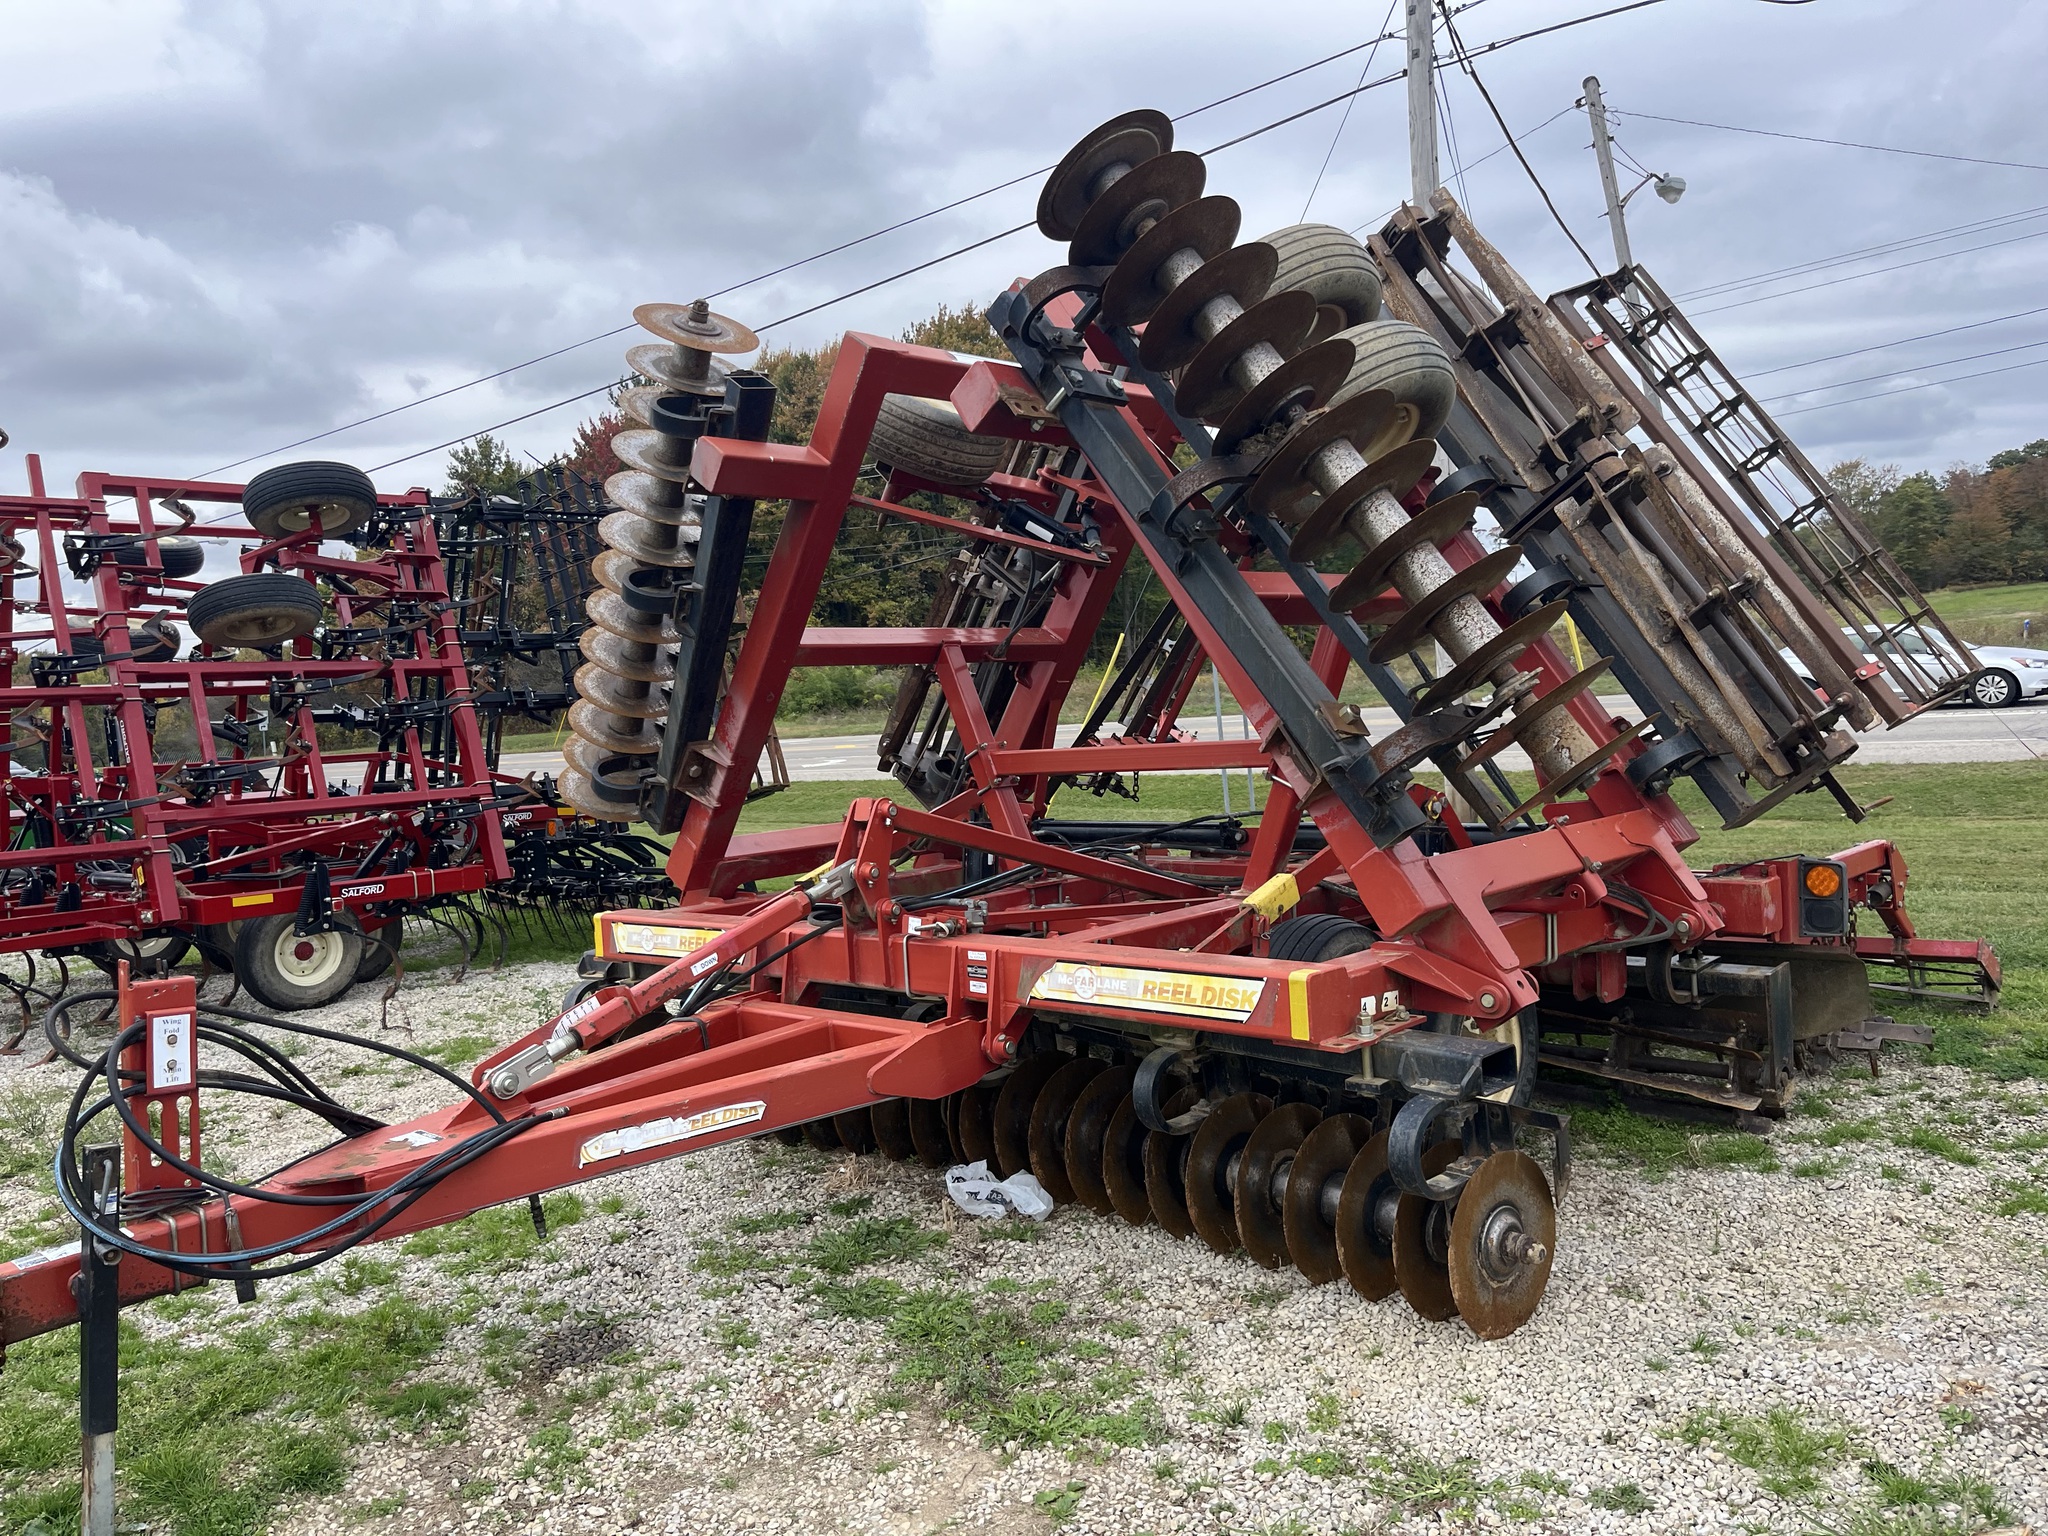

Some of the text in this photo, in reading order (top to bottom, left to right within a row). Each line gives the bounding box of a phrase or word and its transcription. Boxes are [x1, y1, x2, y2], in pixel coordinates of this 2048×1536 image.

[502, 811, 532, 823] SALFORD
[341, 884, 385, 898] SALFORD
[700, 956, 717, 969] DOWN
[1057, 973, 1259, 1010] McFARLANE REEL DISK
[1384, 997, 1389, 1007] 2
[1394, 994, 1398, 1005] 1
[163, 1027, 180, 1035] Fold
[690, 1113, 720, 1130] EEL
[722, 1106, 759, 1121] DISK
